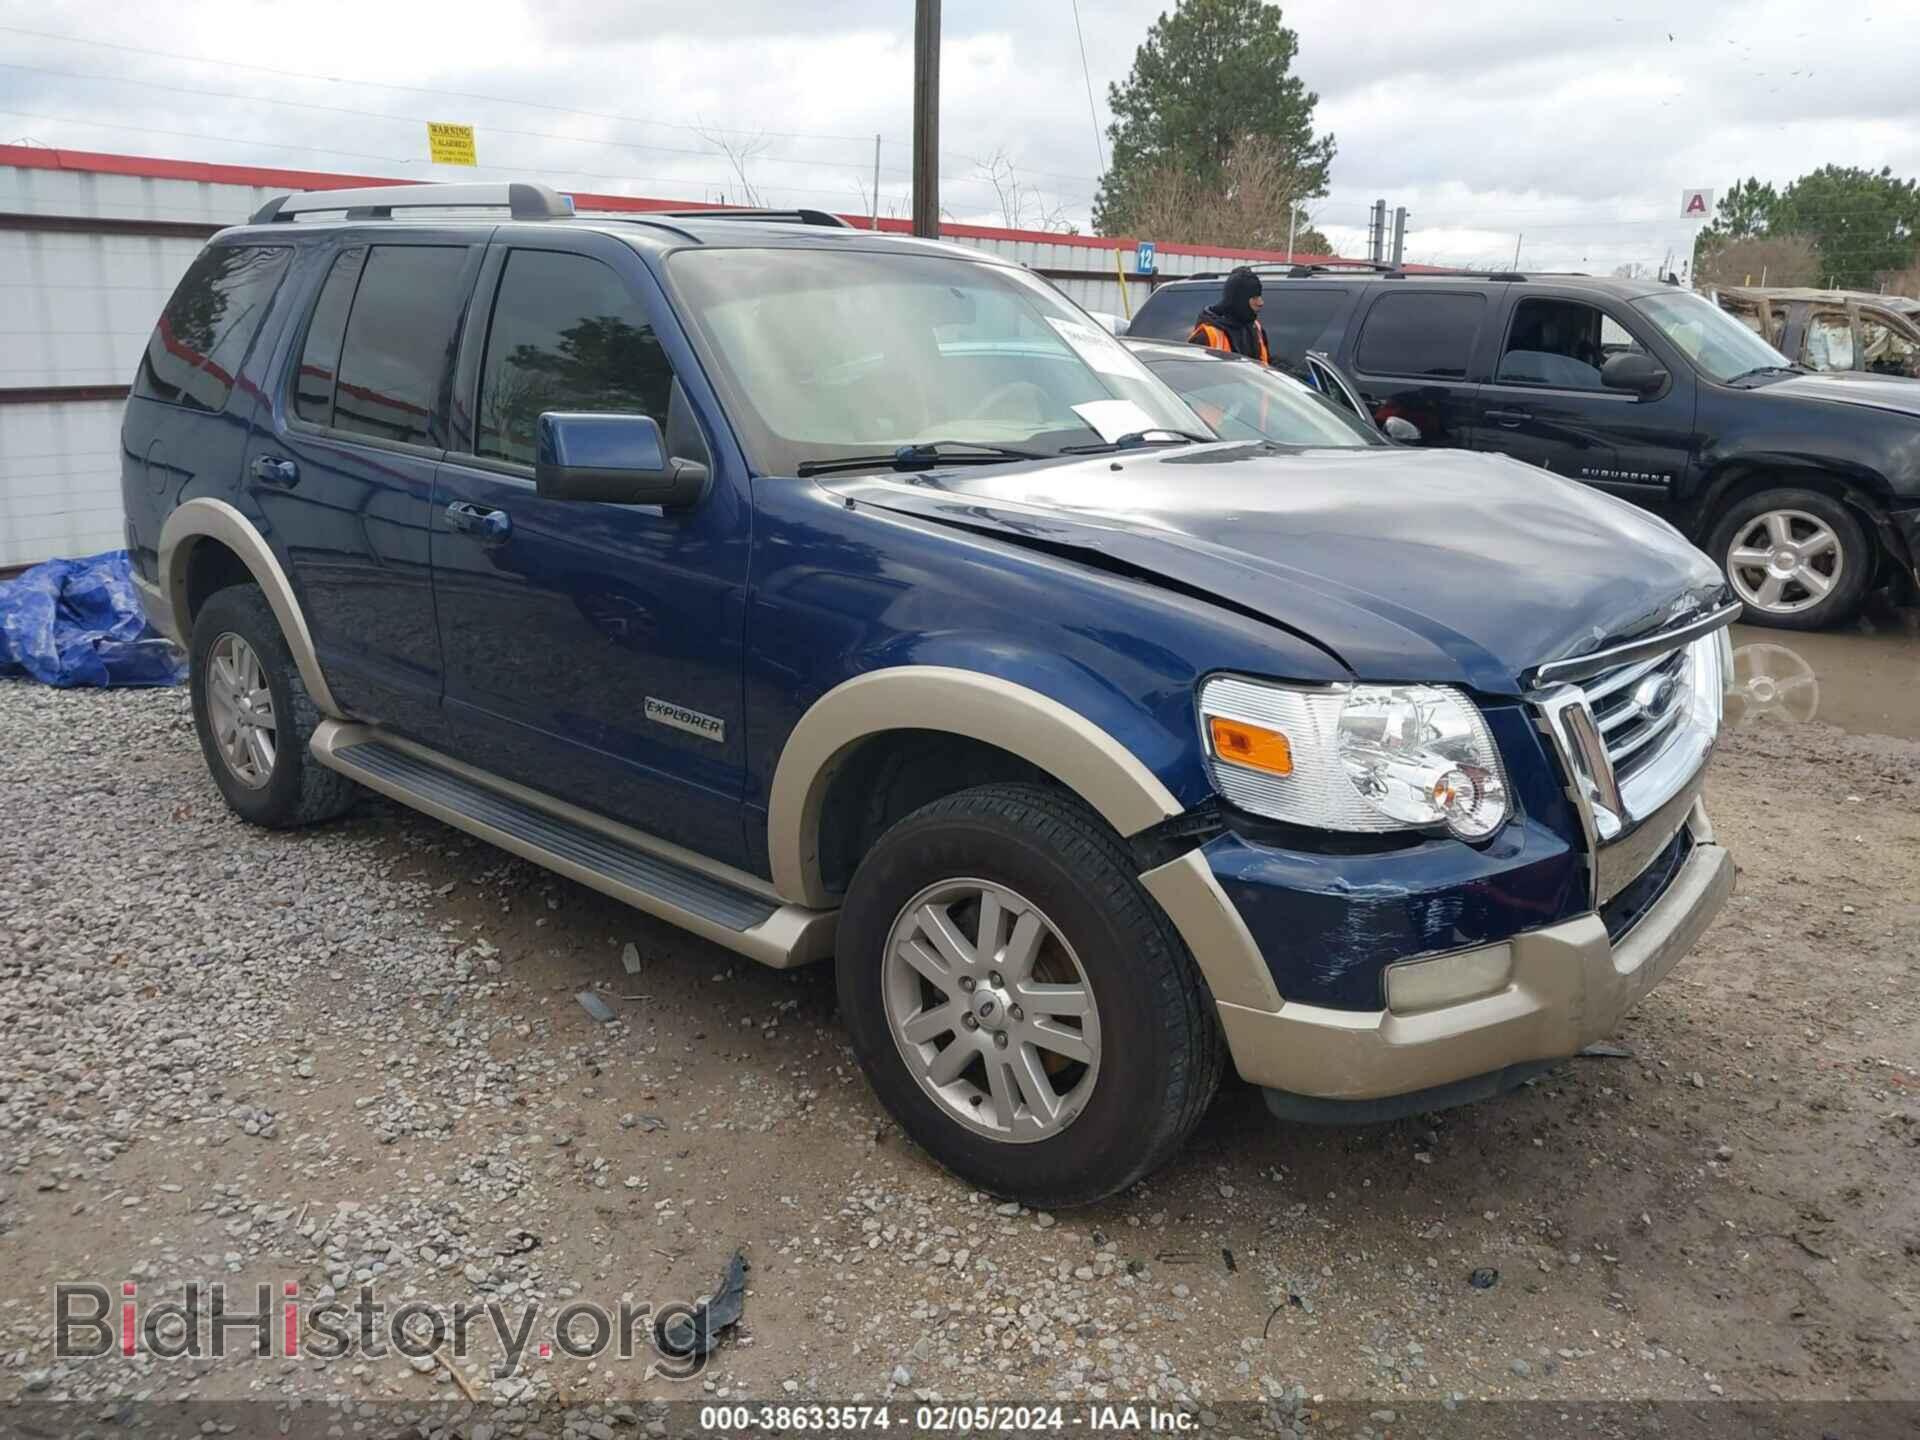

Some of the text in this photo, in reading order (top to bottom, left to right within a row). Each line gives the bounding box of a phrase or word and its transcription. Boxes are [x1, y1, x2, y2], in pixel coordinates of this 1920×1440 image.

[430, 125, 471, 137] WARNING
[1686, 194, 1706, 213] A
[1140, 248, 1152, 269] 12
[1582, 468, 1660, 481] SUBURBAN
[646, 701, 720, 733] EXPLORER
